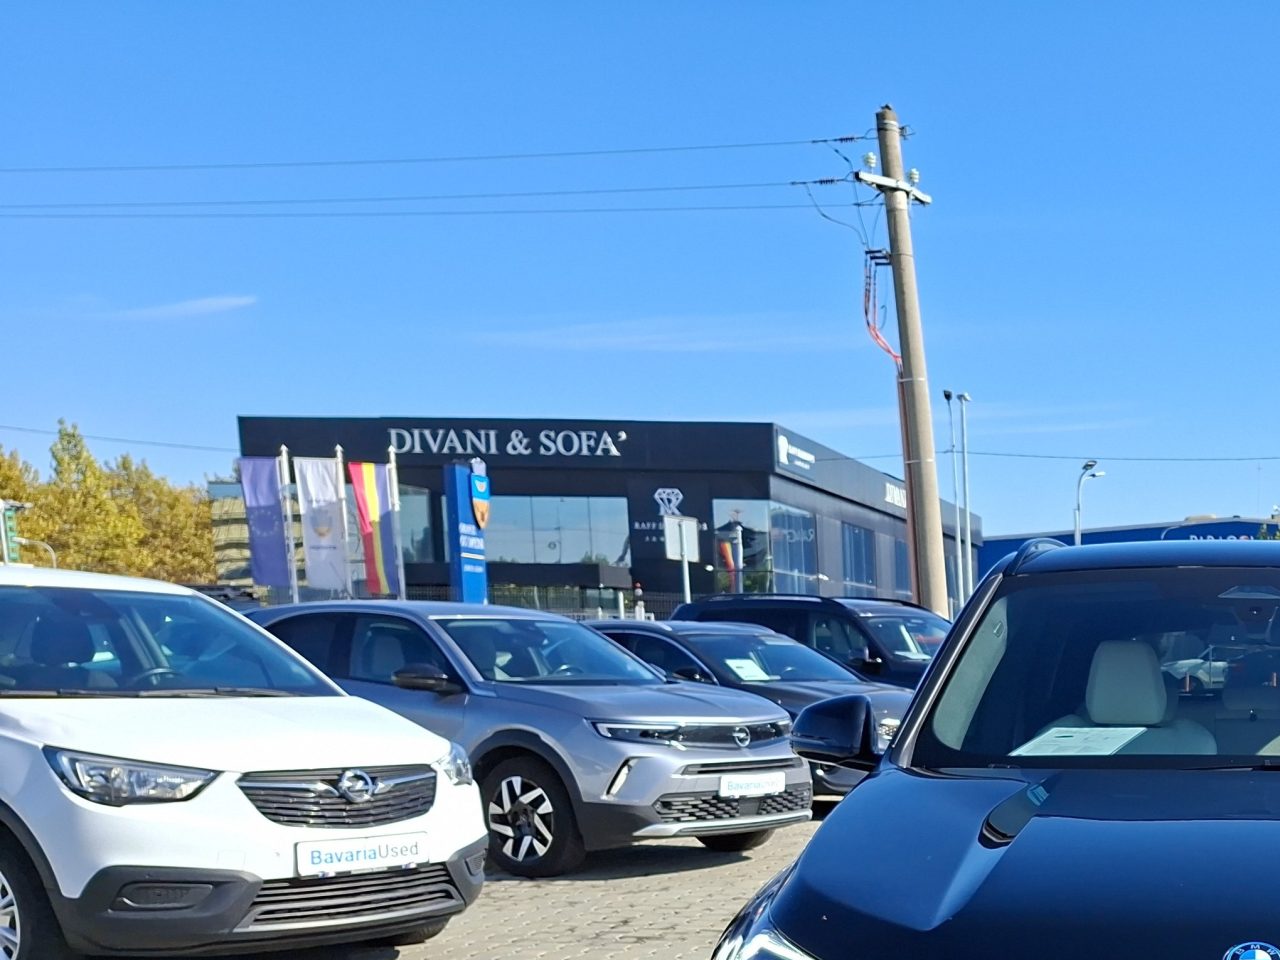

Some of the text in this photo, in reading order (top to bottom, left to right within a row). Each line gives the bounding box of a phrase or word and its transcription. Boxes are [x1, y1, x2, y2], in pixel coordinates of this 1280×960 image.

[388, 428, 499, 455] DIVANI
[506, 429, 532, 456] &
[310, 841, 419, 865] BavariaUsed
[1235, 944, 1277, 955] BMW
